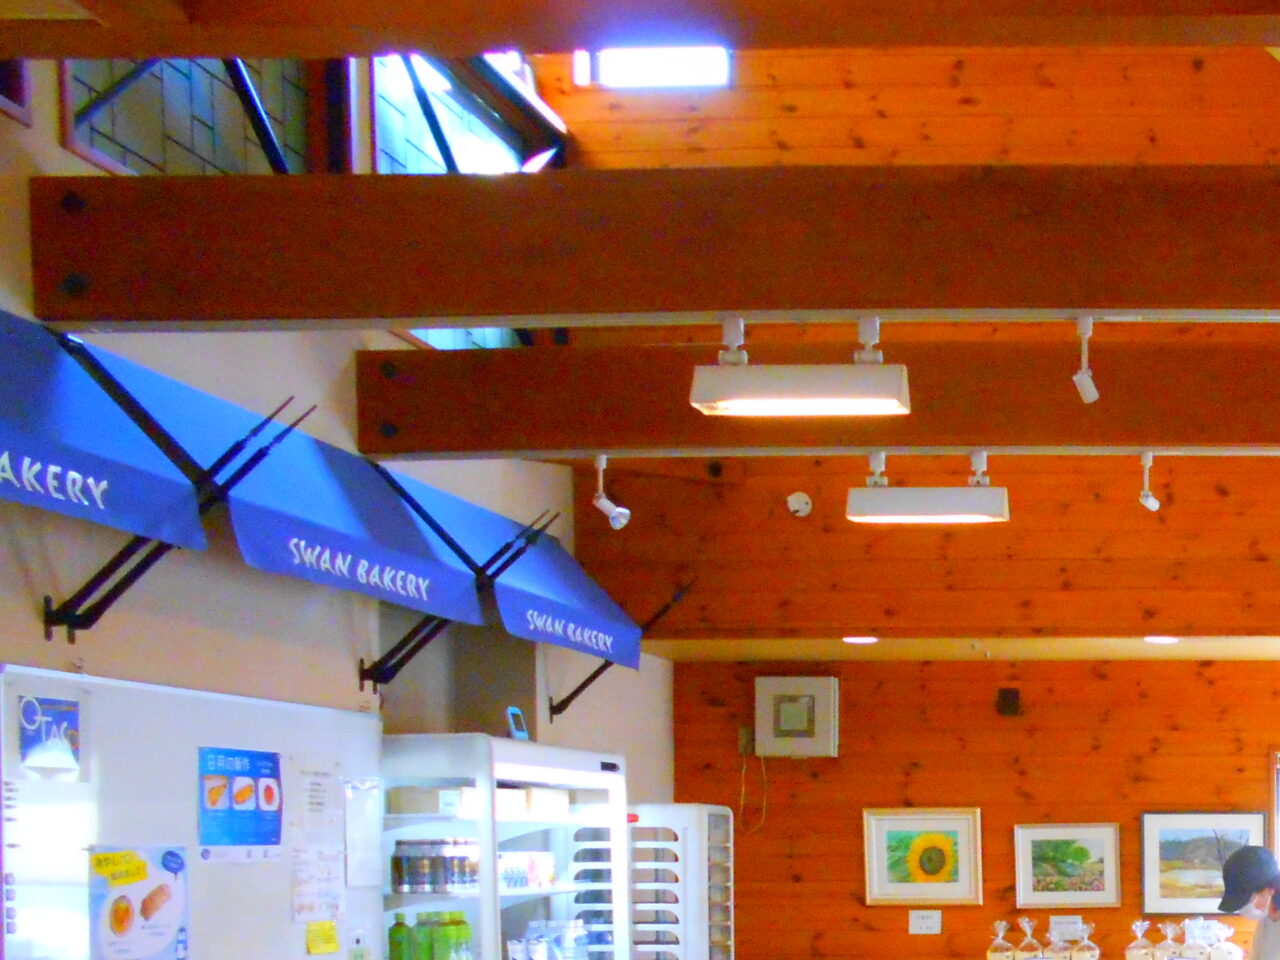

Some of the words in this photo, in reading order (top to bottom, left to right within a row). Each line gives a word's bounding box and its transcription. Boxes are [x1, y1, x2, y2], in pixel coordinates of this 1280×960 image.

[289, 537, 352, 578] SWAN
[356, 559, 429, 601] BAKERY
[527, 609, 565, 636] SWAN
[567, 623, 614, 654] BAKERY
